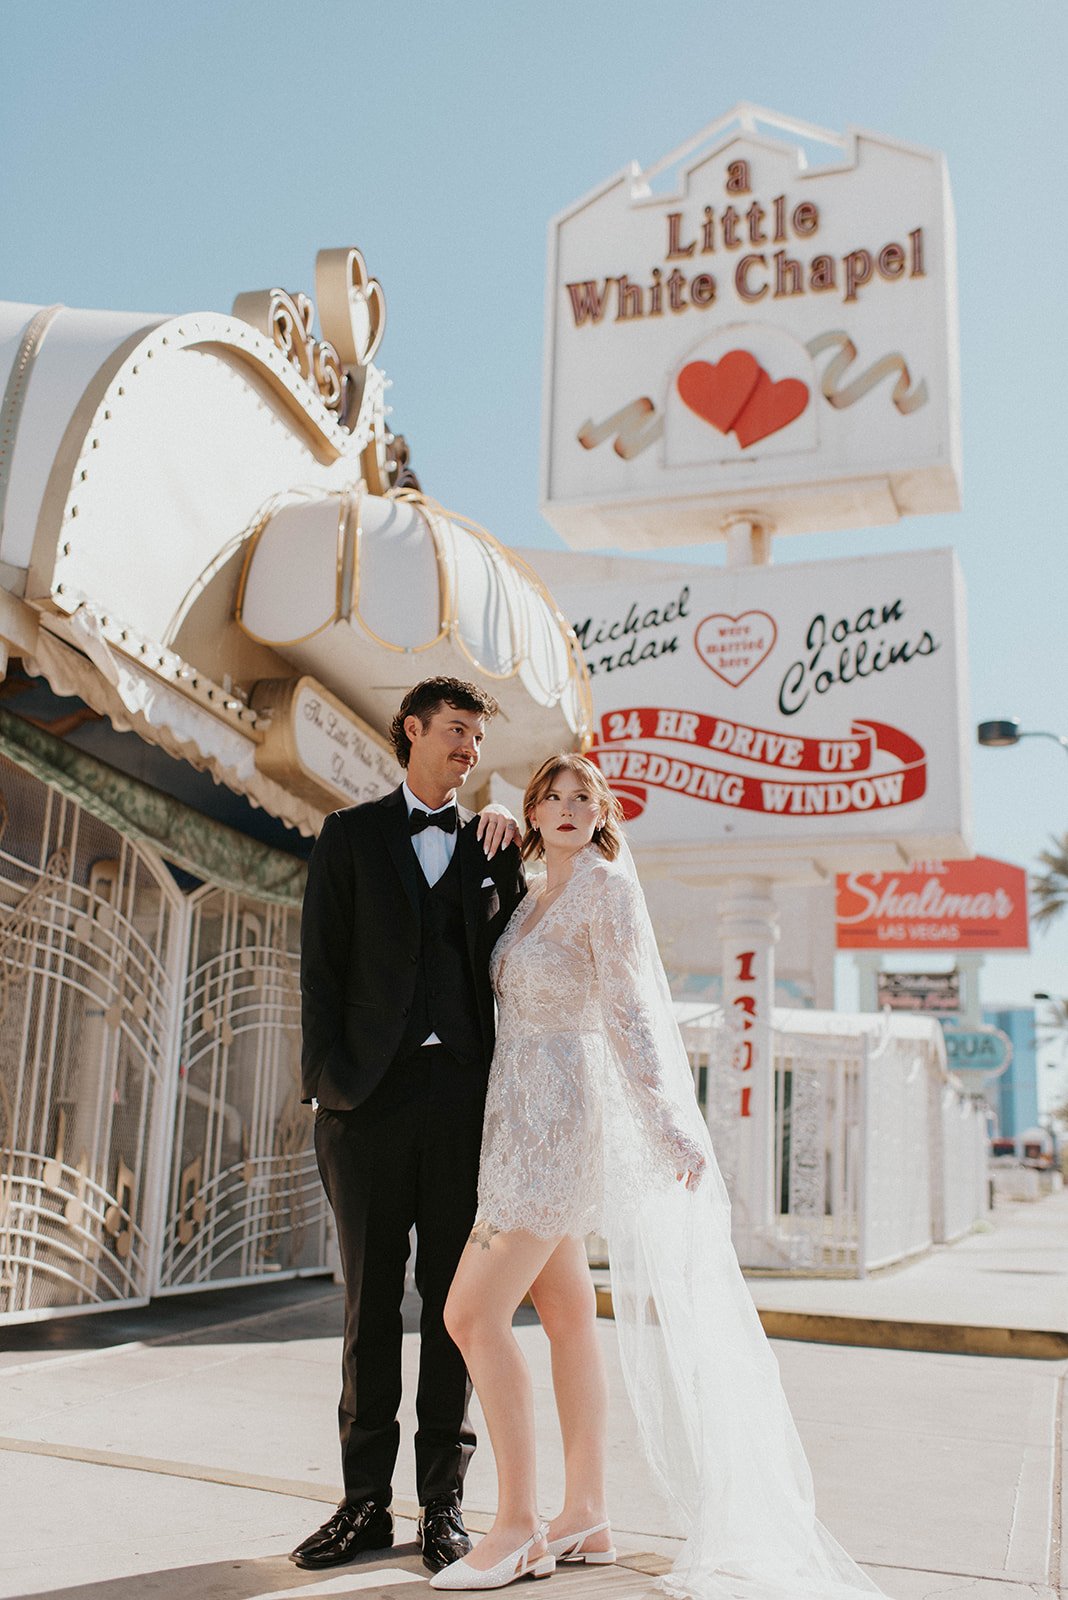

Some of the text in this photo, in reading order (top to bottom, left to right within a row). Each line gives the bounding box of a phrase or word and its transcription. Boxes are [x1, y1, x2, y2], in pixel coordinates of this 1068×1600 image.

[726, 159, 751, 197] a
[665, 195, 820, 262] Little
[566, 227, 926, 328] White Chapel
[571, 585, 690, 651] Michael
[706, 636, 765, 655] married
[718, 625, 750, 638] were
[806, 599, 907, 671] Joan
[586, 636, 679, 676] ordan
[719, 657, 750, 669] here
[779, 631, 942, 716] Collins
[608, 710, 862, 771] 24 HR DRIVE UP
[597, 752, 905, 813] WEDDING WINDOW
[836, 870, 1014, 925] Shalimar
[876, 924, 961, 942] LAS VEGAS
[944, 1035, 997, 1058] QUA
